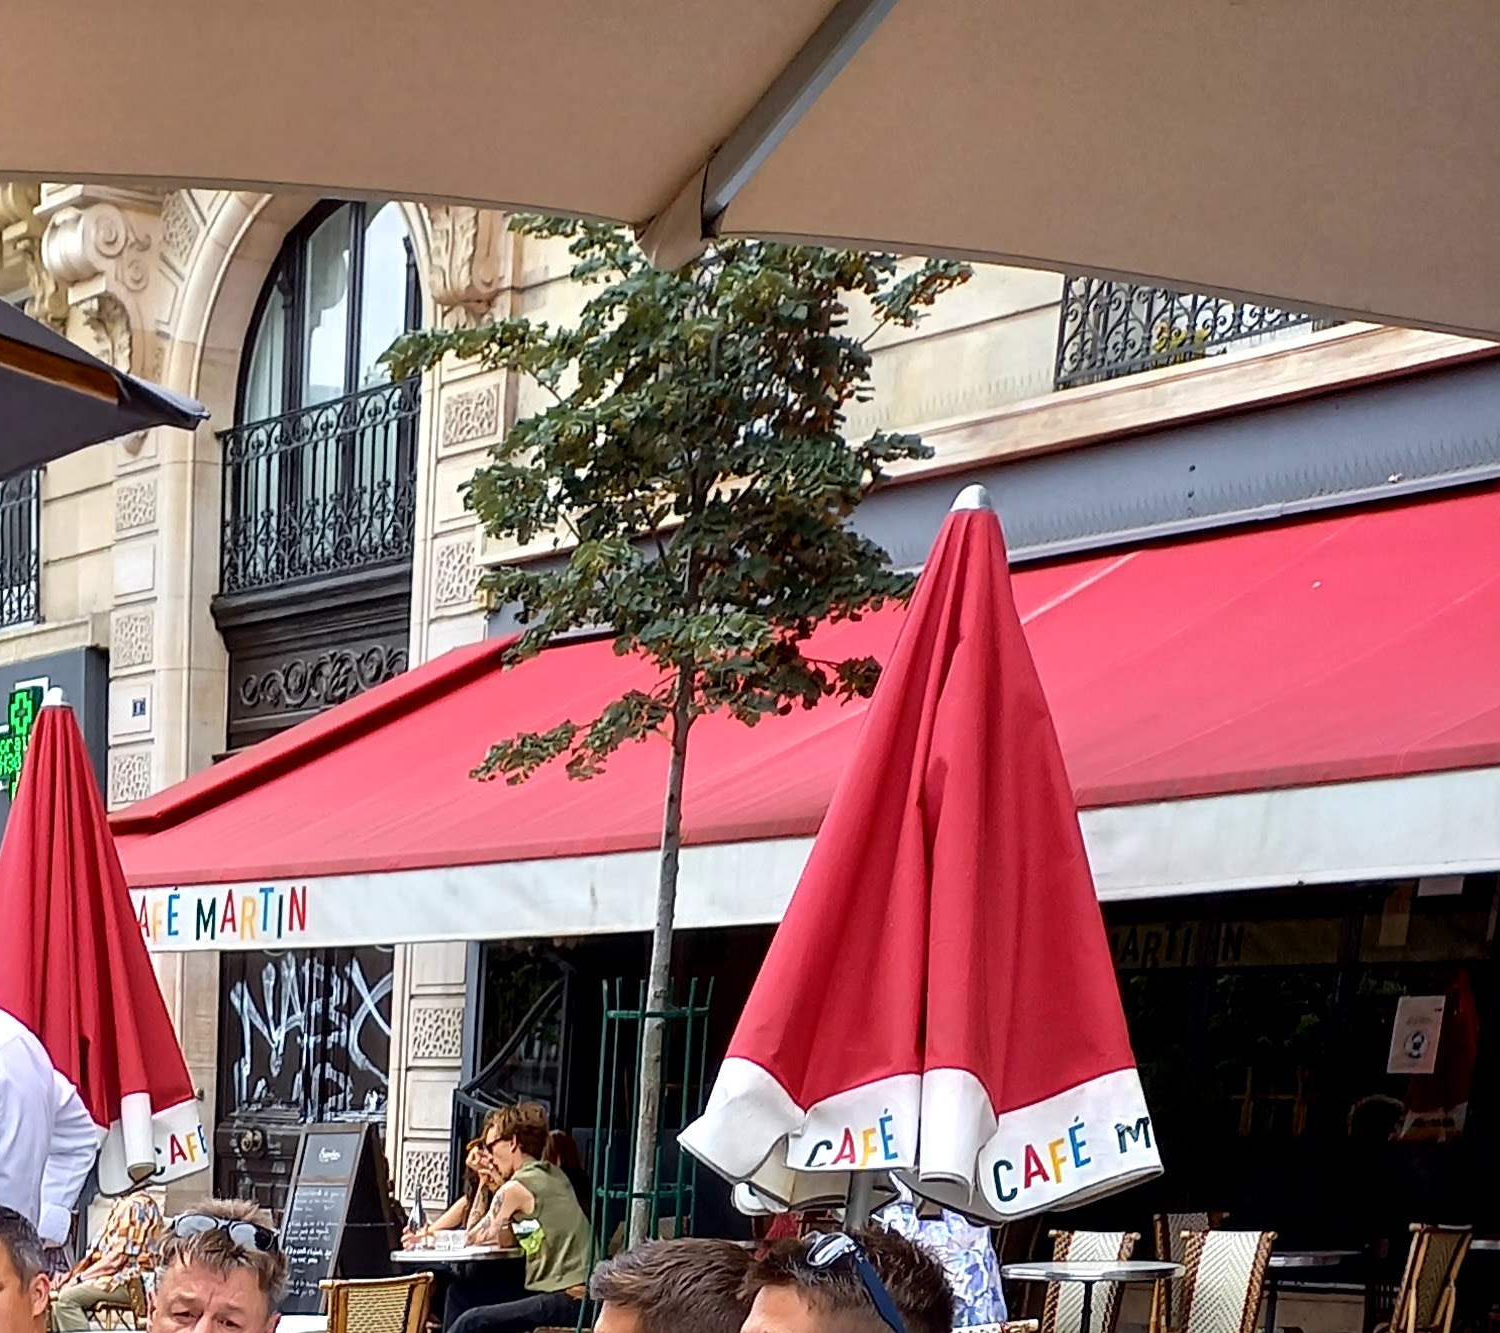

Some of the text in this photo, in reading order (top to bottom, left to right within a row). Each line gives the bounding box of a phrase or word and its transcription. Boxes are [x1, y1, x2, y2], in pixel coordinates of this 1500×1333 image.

[137, 885, 307, 944] AFÉ MARTIN
[1111, 923, 1246, 968] ARTIN
[804, 1109, 898, 1168] CAFÉ
[993, 1116, 1152, 1203] CAFÉ M
